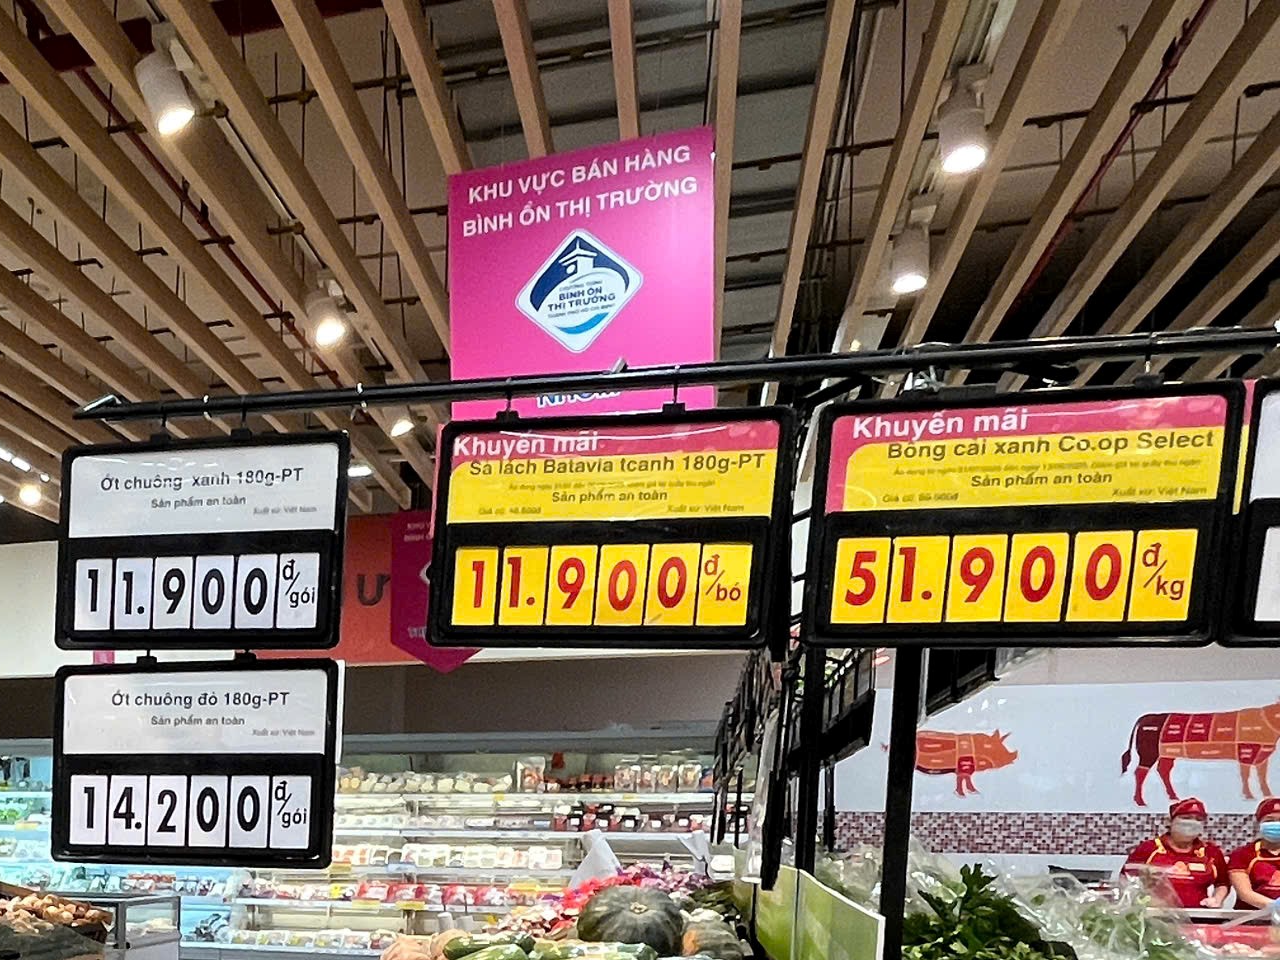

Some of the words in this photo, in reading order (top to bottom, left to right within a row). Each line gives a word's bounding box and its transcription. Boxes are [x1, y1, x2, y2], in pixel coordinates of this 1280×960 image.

[468, 179, 513, 205] KHU
[518, 169, 566, 195] VỰC
[572, 157, 618, 183] BÁN
[624, 145, 691, 174] HÀNG
[463, 209, 513, 238] BÌNH
[556, 196, 591, 219] THỊ
[596, 176, 698, 210] TRƯỜNG
[852, 410, 963, 441] Khuyến
[973, 407, 1027, 432] mãi
[454, 432, 545, 460] Khuyến
[553, 431, 598, 453] mãi
[888, 440, 946, 461] Bông
[994, 436, 1050, 455] xanh
[1058, 435, 1128, 454] Co.op
[1136, 430, 1214, 450] Select
[543, 458, 613, 474] Batavia
[683, 453, 765, 474] 180g-PT
[101, 473, 119, 491] Ớt
[124, 474, 183, 491] chuông
[192, 471, 230, 487] xanh
[237, 467, 304, 487] 180g-PT
[971, 475, 1000, 487] Sản
[1005, 472, 1048, 488] phẩm
[1053, 474, 1072, 484] an
[1077, 472, 1112, 484] toàn
[174, 496, 203, 509] phẩm
[206, 498, 220, 507] an
[222, 495, 246, 506] toàn
[552, 491, 576, 503] Sản
[618, 492, 635, 501] an
[638, 490, 668, 501] toàn
[472, 555, 687, 612] 11.900
[844, 542, 1122, 607] 51.900
[87, 567, 269, 616] 11.900
[111, 690, 130, 706] Ớt
[134, 690, 193, 709] chuông
[197, 690, 218, 706] đỏ
[224, 691, 290, 709] 180g-PT
[151, 714, 171, 726] Sản
[174, 714, 203, 727] phẩm
[205, 716, 219, 725] an
[221, 715, 245, 726] toàn
[83, 786, 261, 833] 14.200
